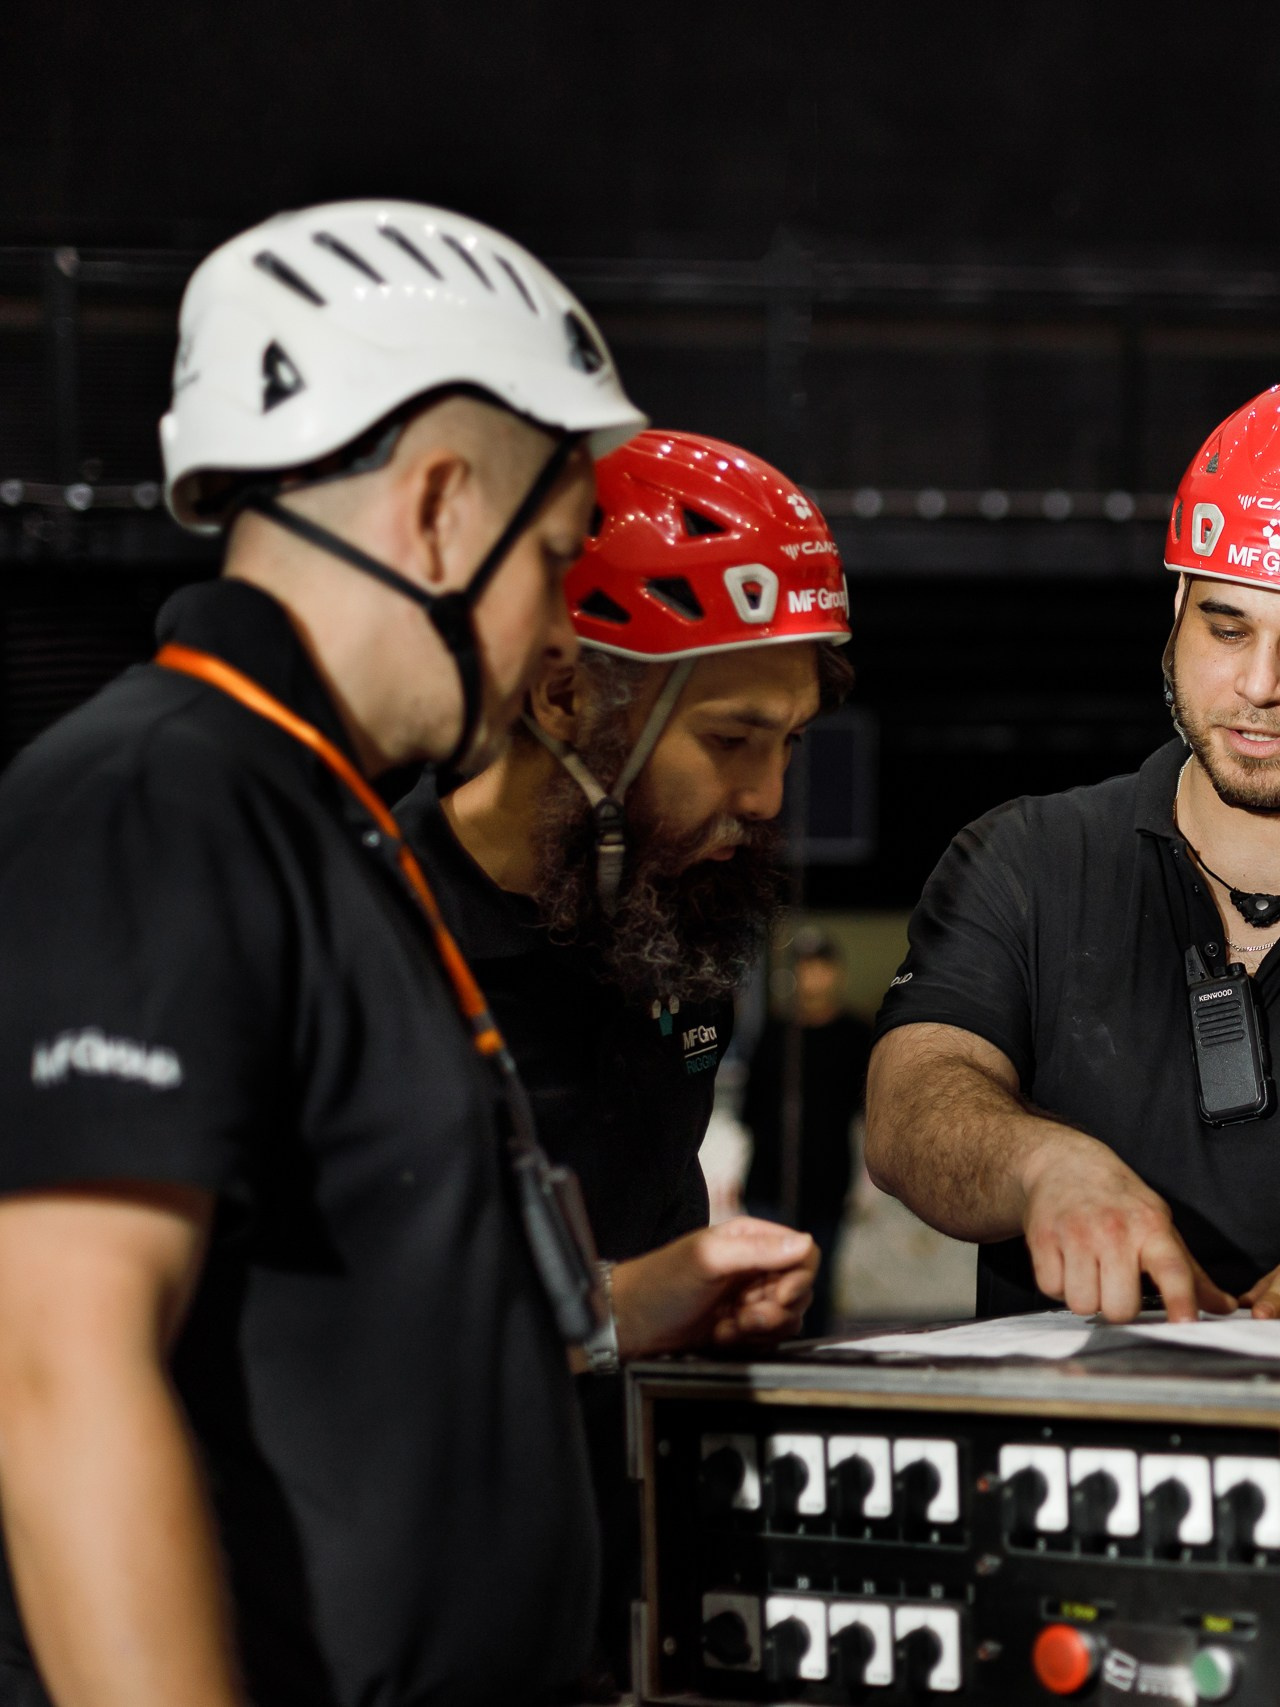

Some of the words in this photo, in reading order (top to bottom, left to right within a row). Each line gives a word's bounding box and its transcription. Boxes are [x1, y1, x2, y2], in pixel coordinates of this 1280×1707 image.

[1227, 544, 1262, 567] MF
[788, 589, 816, 613] MF
[1198, 988, 1233, 1002] KENWOOD
[686, 1053, 718, 1075] RIGGIN
